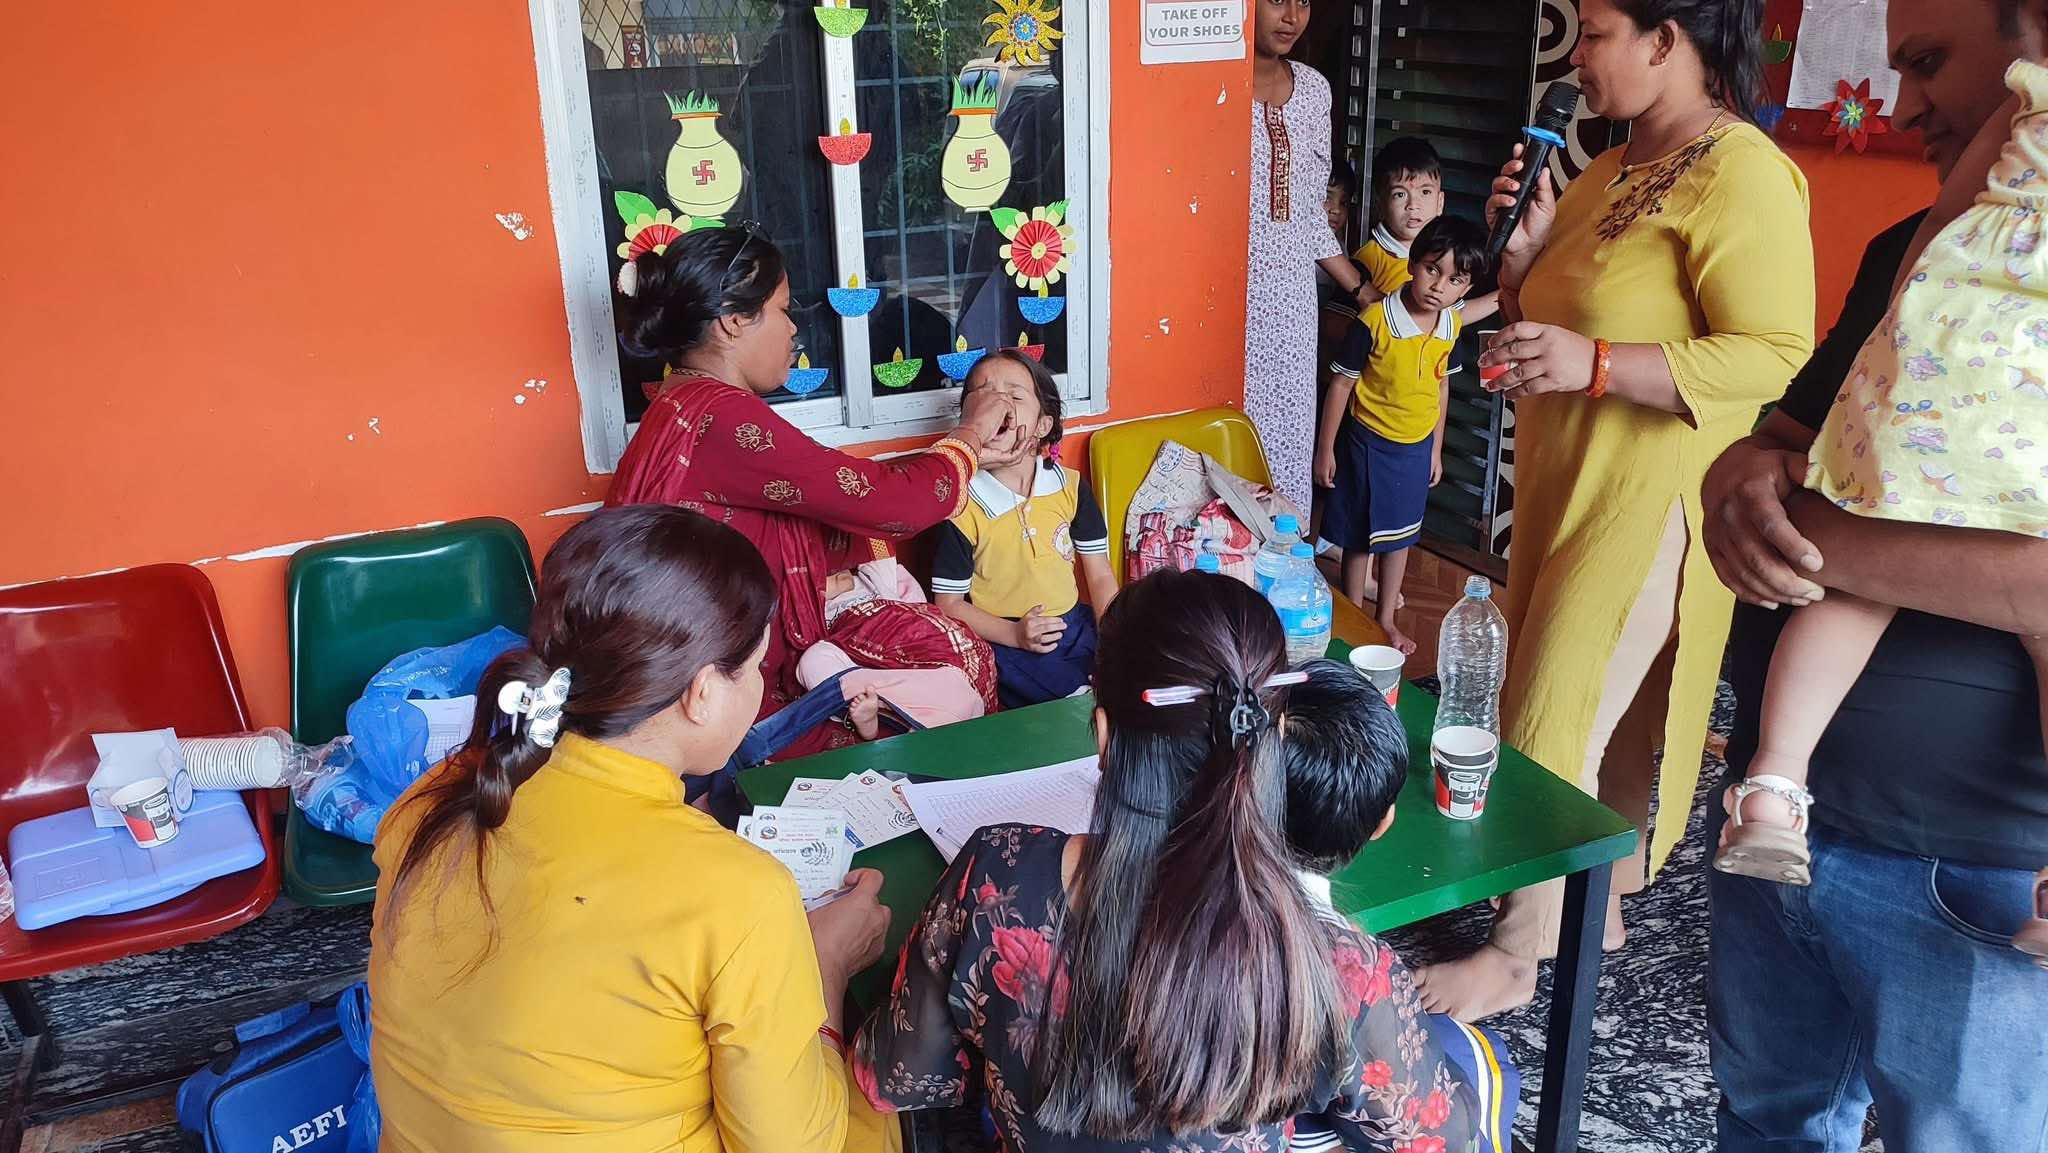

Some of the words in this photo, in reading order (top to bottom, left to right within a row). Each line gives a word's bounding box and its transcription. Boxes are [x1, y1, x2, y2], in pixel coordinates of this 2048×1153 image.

[1162, 9, 1197, 20] TAKE
[1202, 8, 1228, 19] OFF
[1150, 27, 1188, 38] YOUR
[1193, 25, 1240, 36] SHOES
[271, 1104, 348, 1153] AEFI
